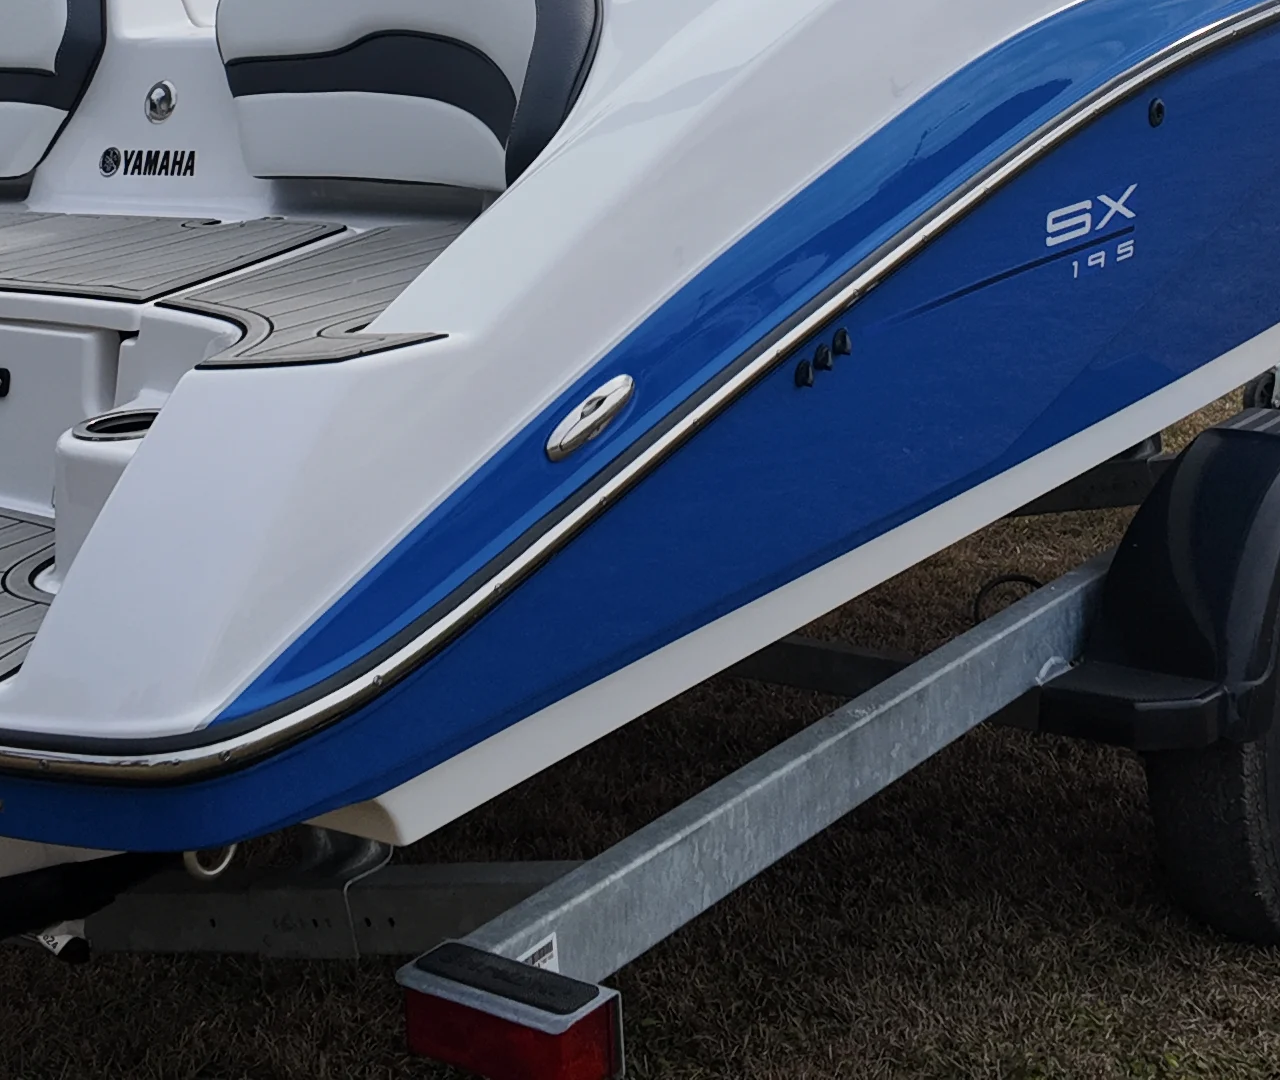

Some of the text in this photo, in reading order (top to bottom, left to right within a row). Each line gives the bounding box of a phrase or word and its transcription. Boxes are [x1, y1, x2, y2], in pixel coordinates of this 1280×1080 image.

[122, 149, 196, 177] YAMAHA
[1045, 182, 1138, 248] SX
[1071, 239, 1135, 279] 195
